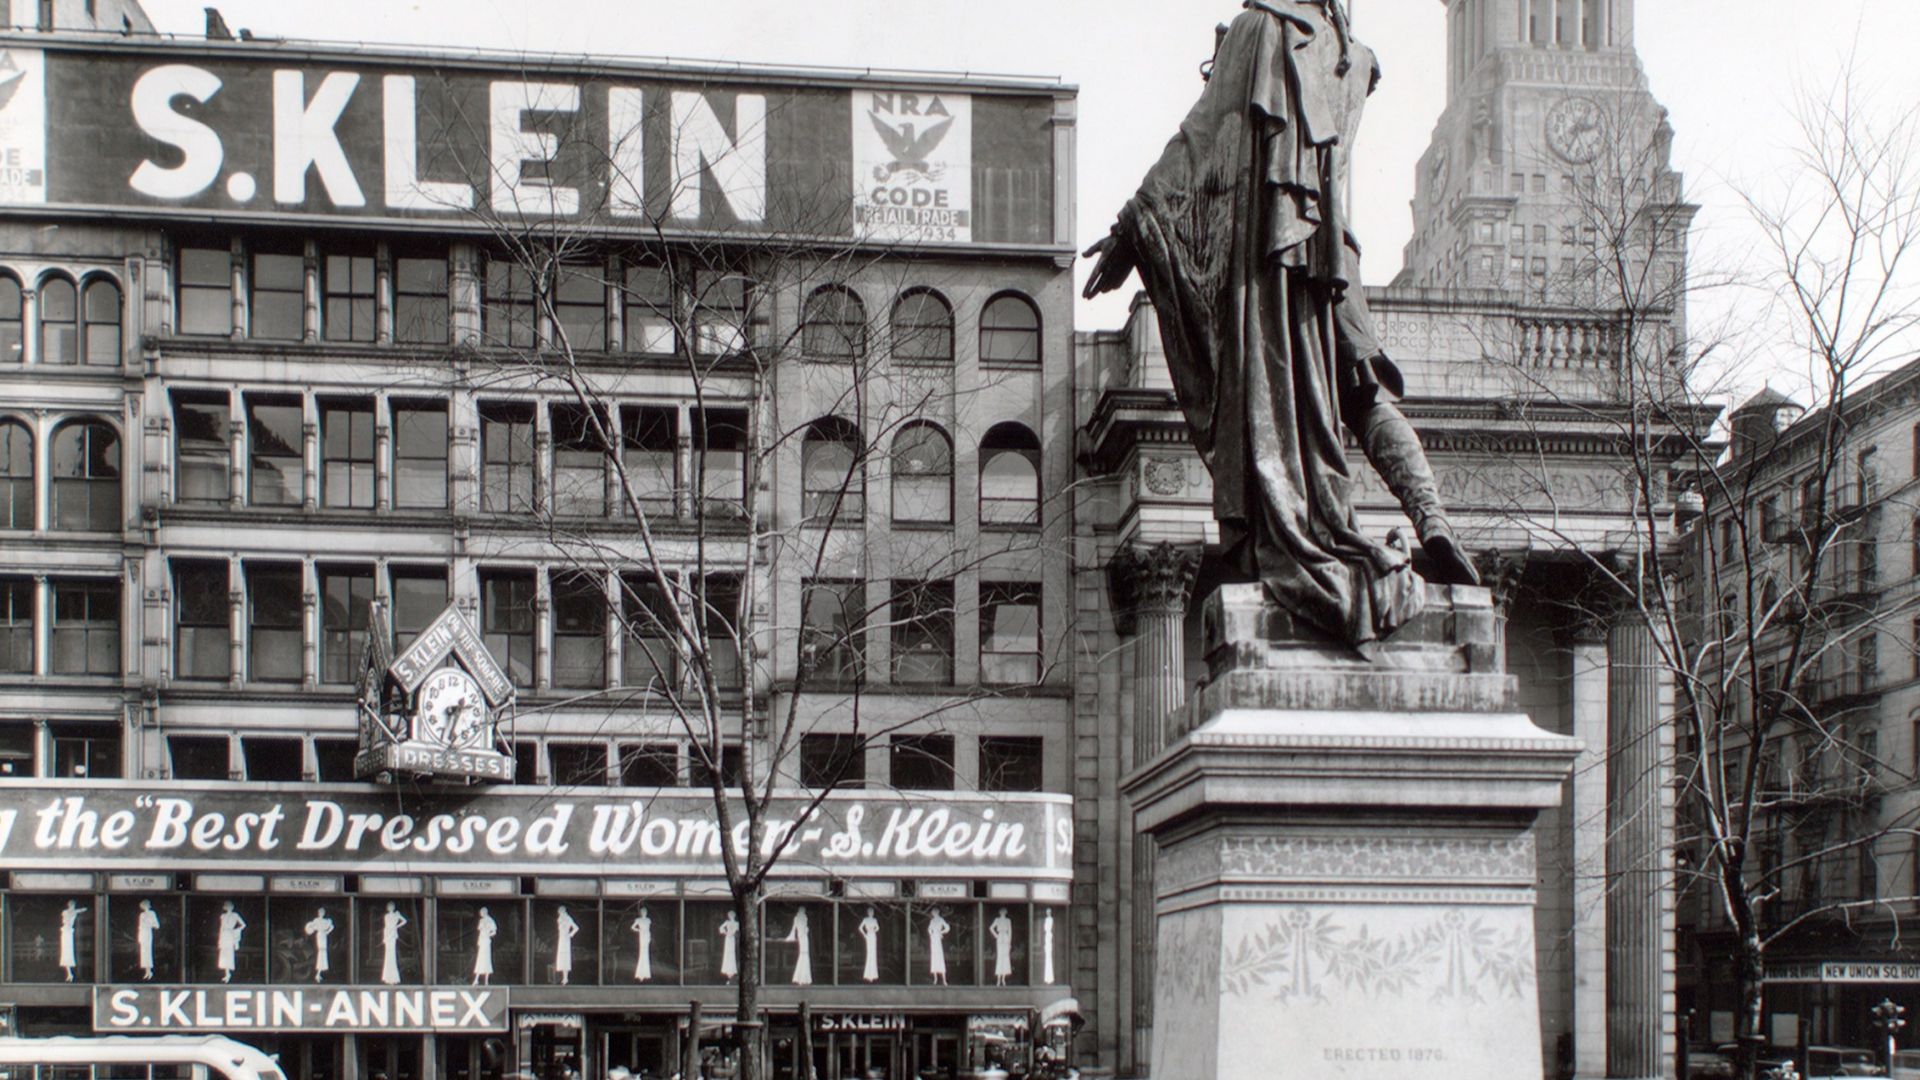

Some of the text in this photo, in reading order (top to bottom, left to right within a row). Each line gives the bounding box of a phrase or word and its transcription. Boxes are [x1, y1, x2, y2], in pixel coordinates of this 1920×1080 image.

[872, 92, 950, 116] NRA
[871, 186, 948, 207] CODE
[913, 209, 959, 227] TRADE
[410, 624, 452, 667] KLEIN
[404, 750, 500, 774] DRESSES
[34, 796, 135, 849] the
[296, 801, 574, 854] Dressed
[1825, 965, 1846, 978] NEW
[1849, 965, 1880, 978] UNION
[1323, 1047, 1401, 1061] ERECTED
